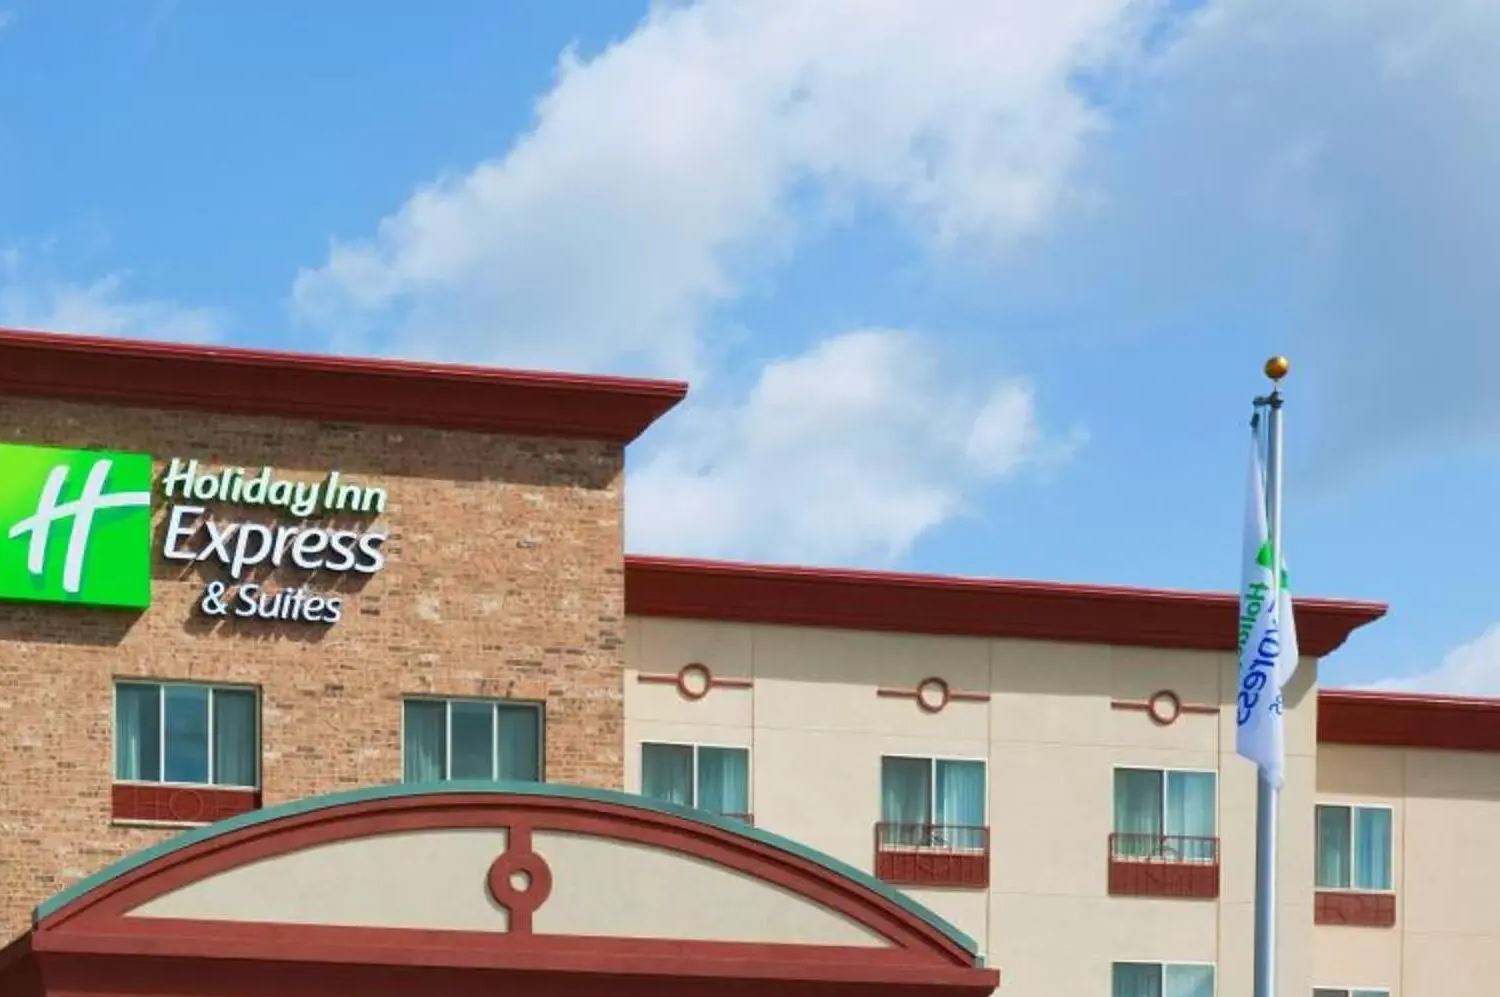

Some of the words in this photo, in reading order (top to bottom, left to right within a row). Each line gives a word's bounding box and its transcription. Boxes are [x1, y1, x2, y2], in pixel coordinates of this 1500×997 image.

[162, 457, 321, 517] Holiday
[325, 471, 388, 513] Inn
[163, 504, 387, 579] Express
[202, 581, 228, 615] &
[235, 583, 344, 623] Suites
